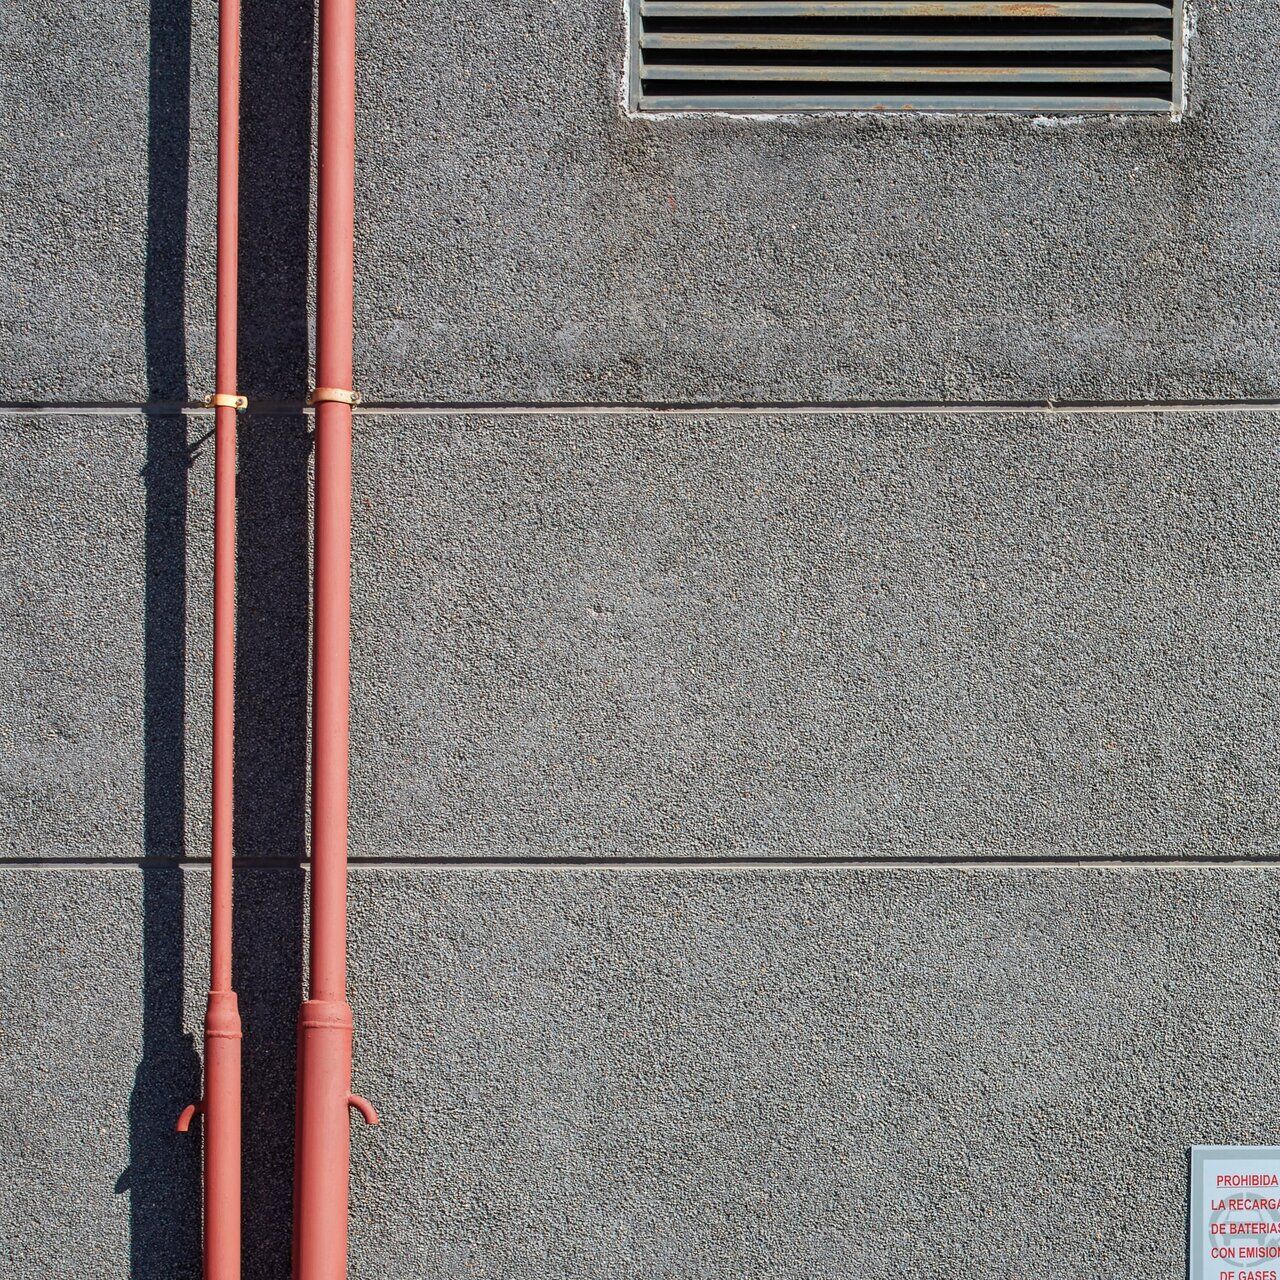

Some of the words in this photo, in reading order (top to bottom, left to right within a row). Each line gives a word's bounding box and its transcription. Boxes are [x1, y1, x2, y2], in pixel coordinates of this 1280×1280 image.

[1216, 1175, 1279, 1186] PROHIBIDA
[1211, 1199, 1226, 1211] LA
[1211, 1223, 1226, 1235] DE
[1211, 1247, 1235, 1259] CON
